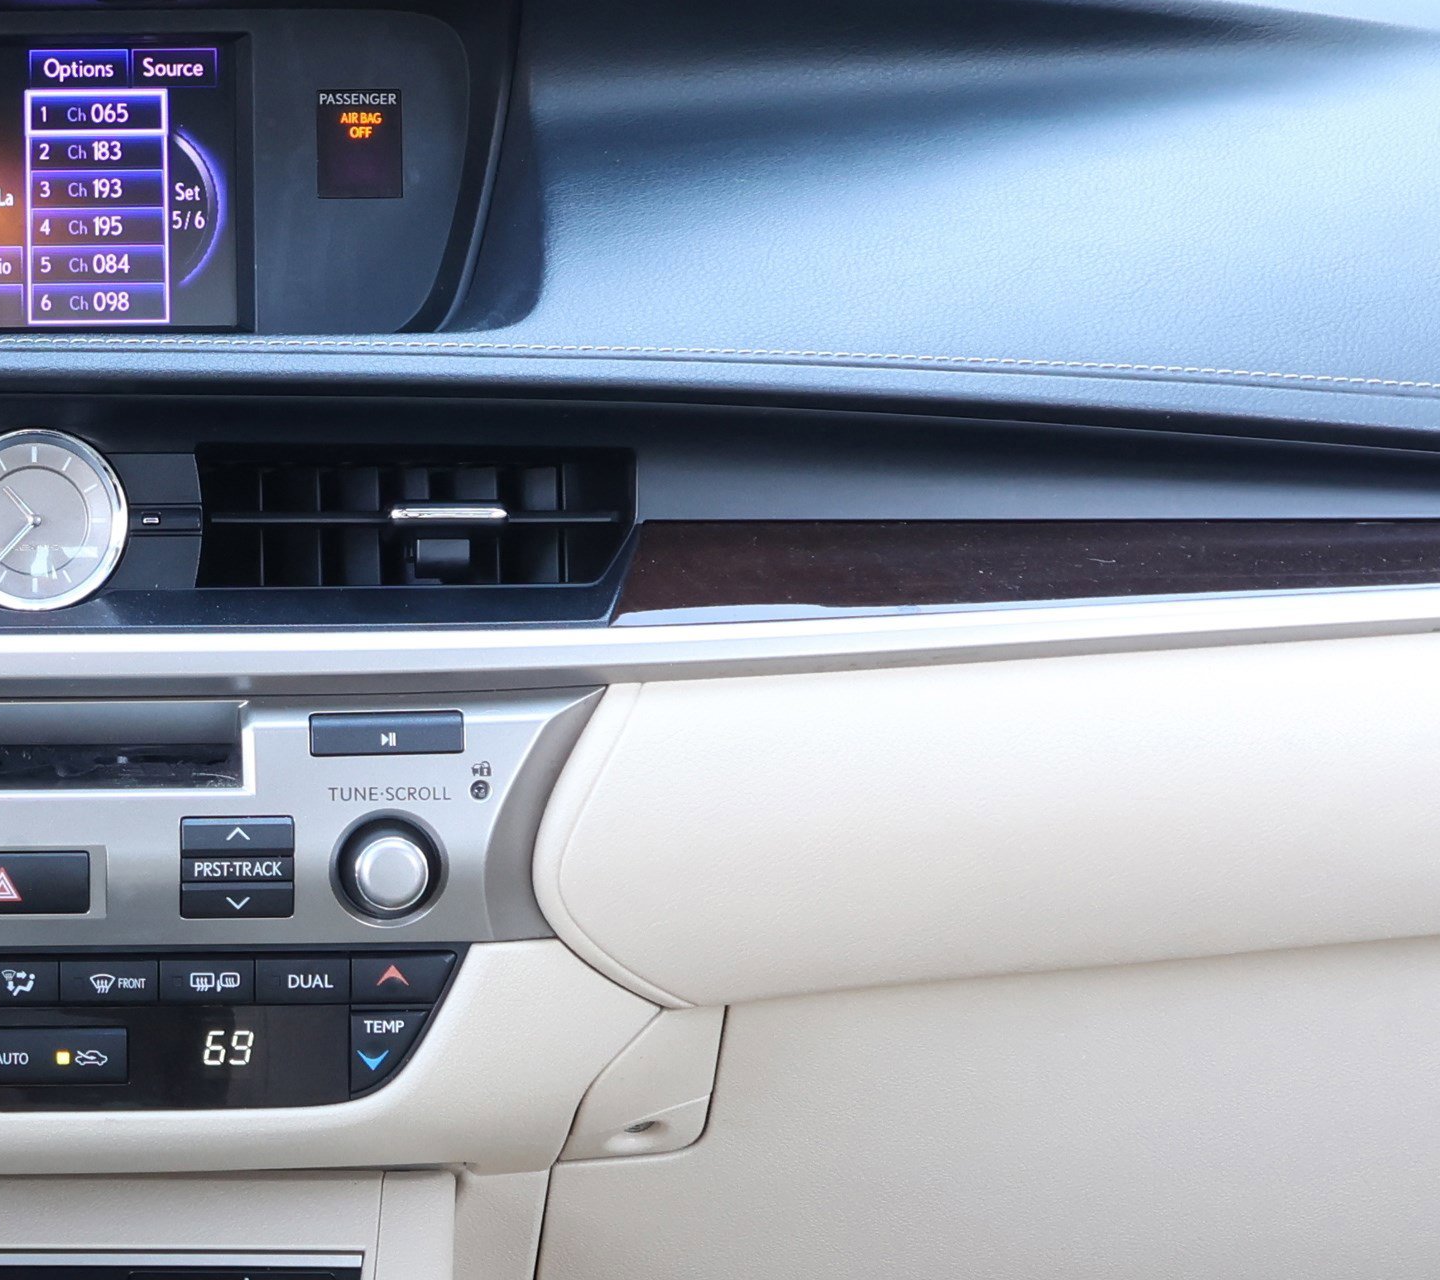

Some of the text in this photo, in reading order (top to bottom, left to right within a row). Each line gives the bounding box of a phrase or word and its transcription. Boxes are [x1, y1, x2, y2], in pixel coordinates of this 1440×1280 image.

[43, 58, 114, 83] Options
[142, 57, 204, 77] Source
[319, 93, 397, 105] PASSENGER
[40, 103, 129, 123] 1 Ch 065
[340, 112, 383, 125] AIR BAG
[349, 126, 373, 139] OFF
[39, 140, 123, 161] 2 Ch 183
[39, 178, 123, 199] 3 Ch 193
[174, 182, 201, 201] Set
[39, 216, 123, 236] 4 Ch 195
[40, 254, 130, 274] 5 Ch 084
[40, 291, 130, 312] 6 Ch 098
[118, 977, 146, 990] FRONT
[287, 974, 333, 989] DUAL
[364, 1020, 405, 1035] TEMP
[202, 1030, 255, 1067] 69
